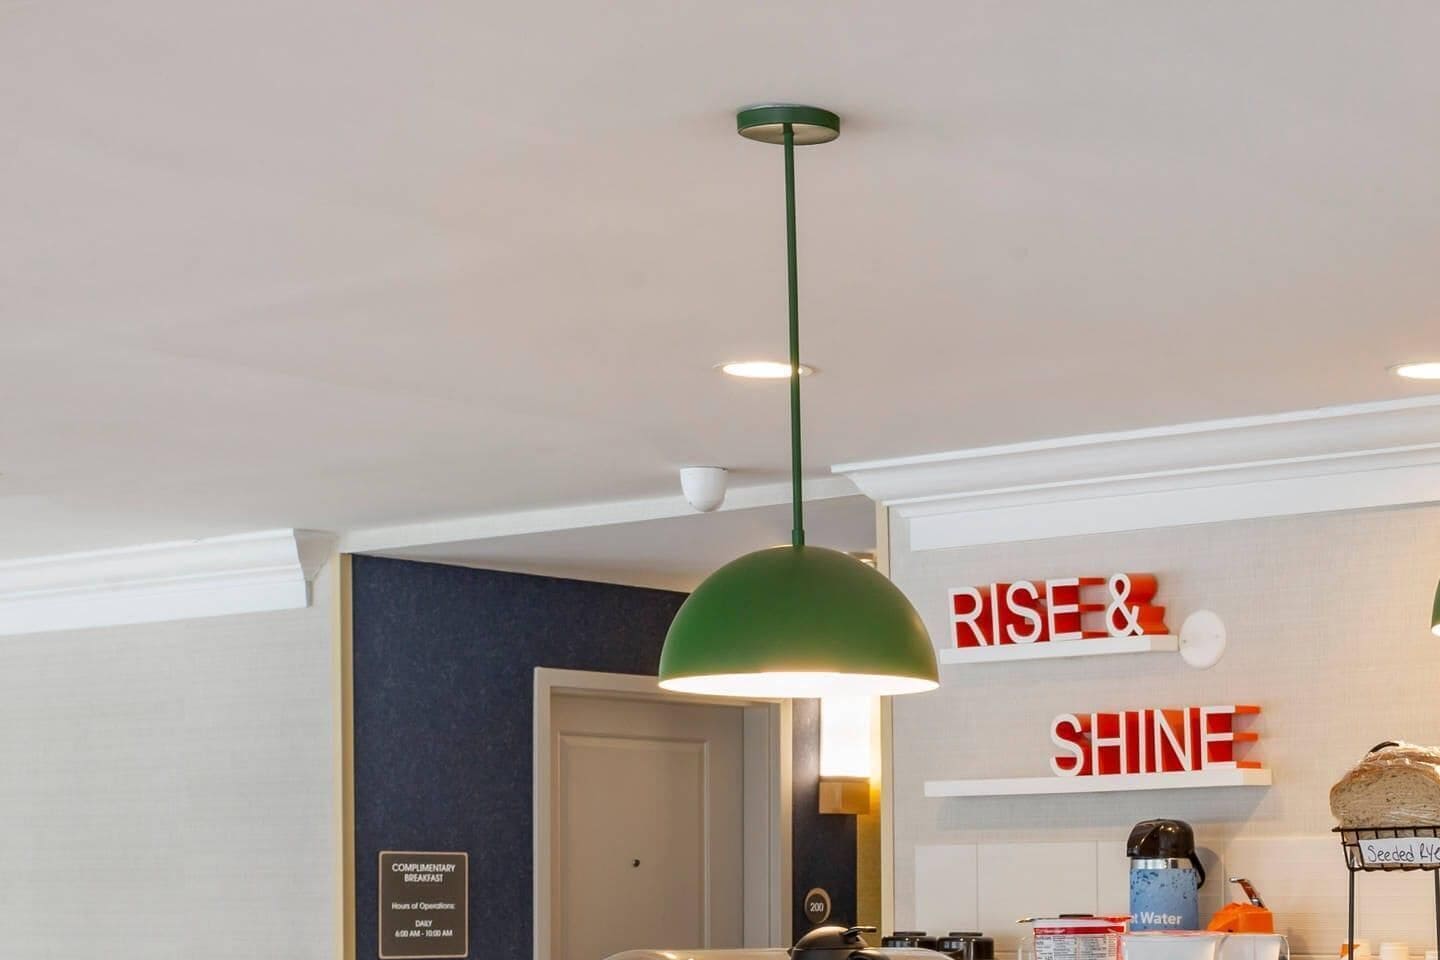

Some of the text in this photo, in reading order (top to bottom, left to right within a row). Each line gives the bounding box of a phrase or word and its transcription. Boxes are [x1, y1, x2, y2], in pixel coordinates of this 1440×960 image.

[947, 573, 1144, 648] RISE &
[1050, 705, 1237, 777] SHINE
[1367, 842, 1415, 862] Seeded
[391, 863, 456, 873] COMPLIMENTARY
[404, 873, 443, 883] BREAKFAST
[391, 902, 410, 910] Hours
[411, 902, 418, 910] of
[810, 902, 825, 912] 200
[1140, 911, 1183, 925] Water
[415, 920, 433, 928] DAILY
